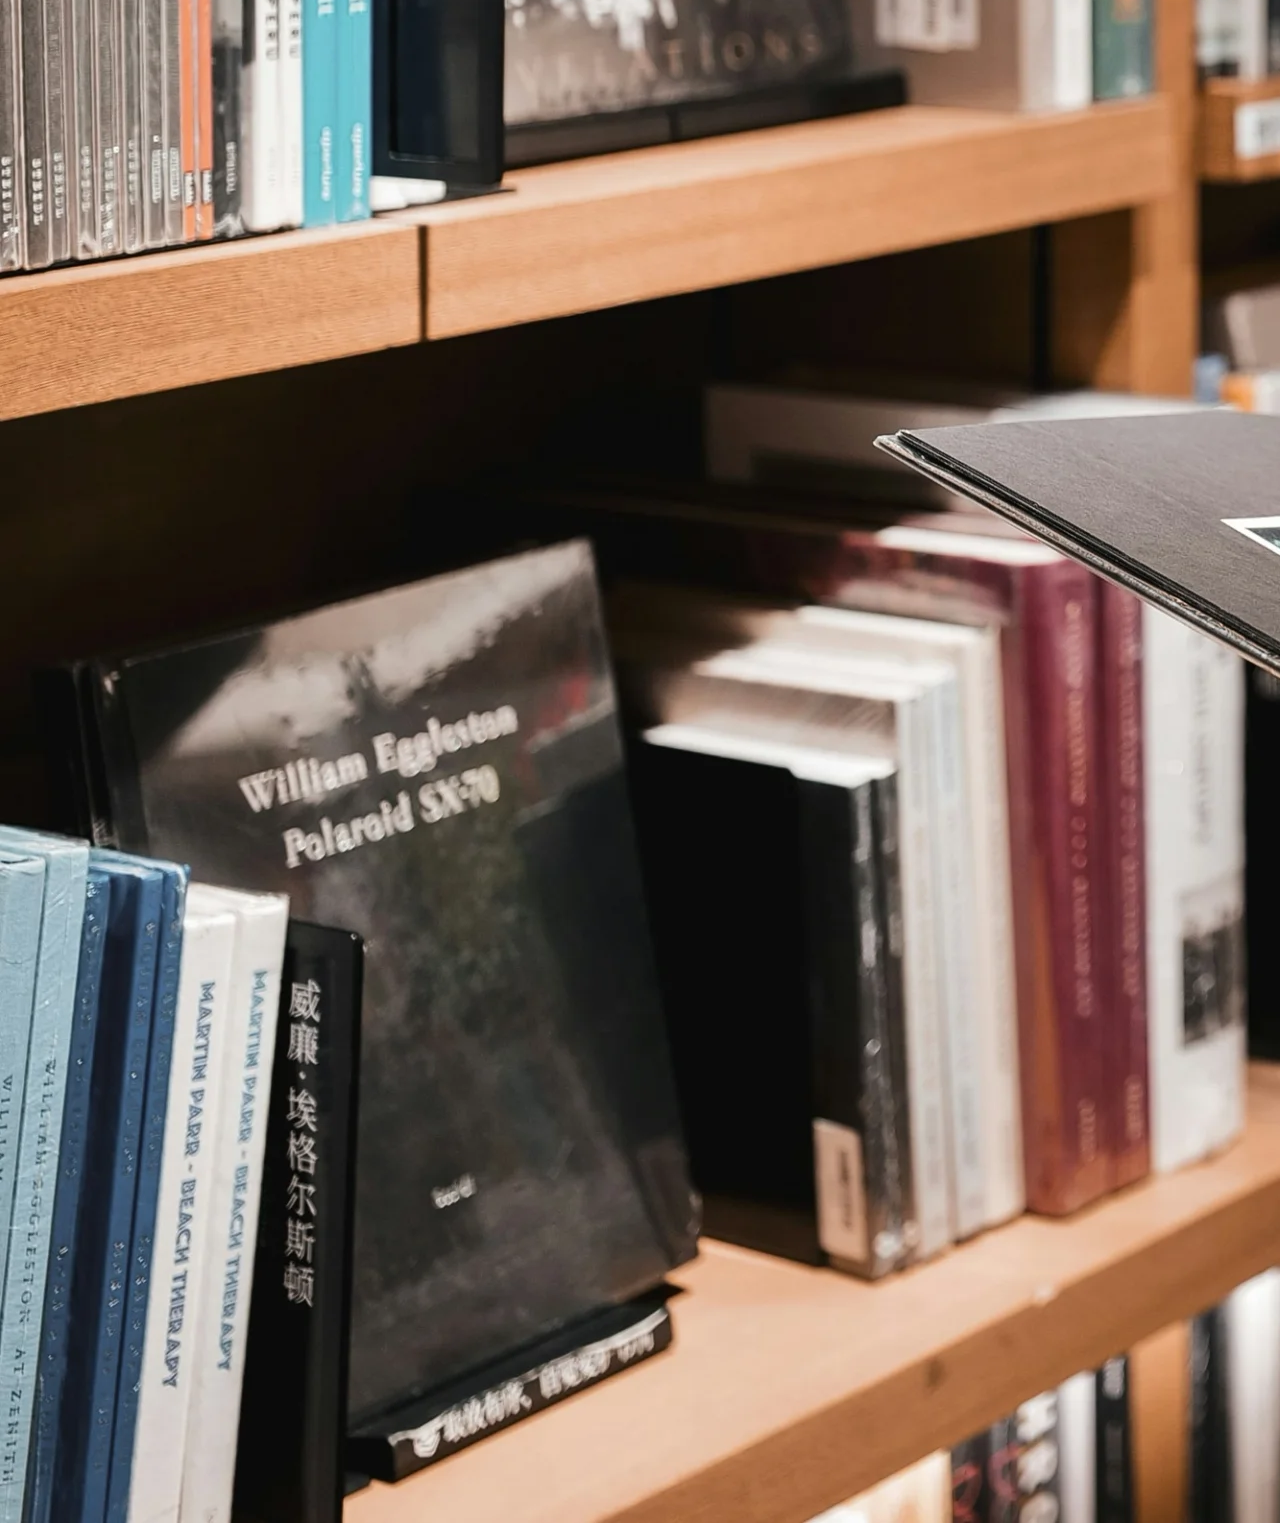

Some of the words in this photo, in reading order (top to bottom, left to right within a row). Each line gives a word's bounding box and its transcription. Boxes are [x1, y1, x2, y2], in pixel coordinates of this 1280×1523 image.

[512, 28, 823, 106] VELATIONS
[1, 156, 12, 223] STEIDL
[32, 158, 43, 225] STEIDL
[53, 152, 64, 219] STEIDL
[238, 752, 369, 813] William
[371, 705, 519, 777] Eggleston
[282, 790, 415, 868] Polaroid
[191, 981, 215, 1083] MARTIN
[242, 969, 267, 1071] MARTIN
[35, 1057, 57, 1167] WILLIAM
[184, 1088, 205, 1165] PARR
[237, 1076, 256, 1150] PARR
[283, 978, 321, 1309] 威廉·埃格尔斯顿
[19, 1177, 45, 1324] EGGLESTON
[174, 1179, 197, 1267] BEACH
[227, 1164, 249, 1250] BEACH
[162, 1270, 188, 1388] THERAPY
[217, 1255, 241, 1371] THERAPY
[13, 1348, 27, 1374] AT
